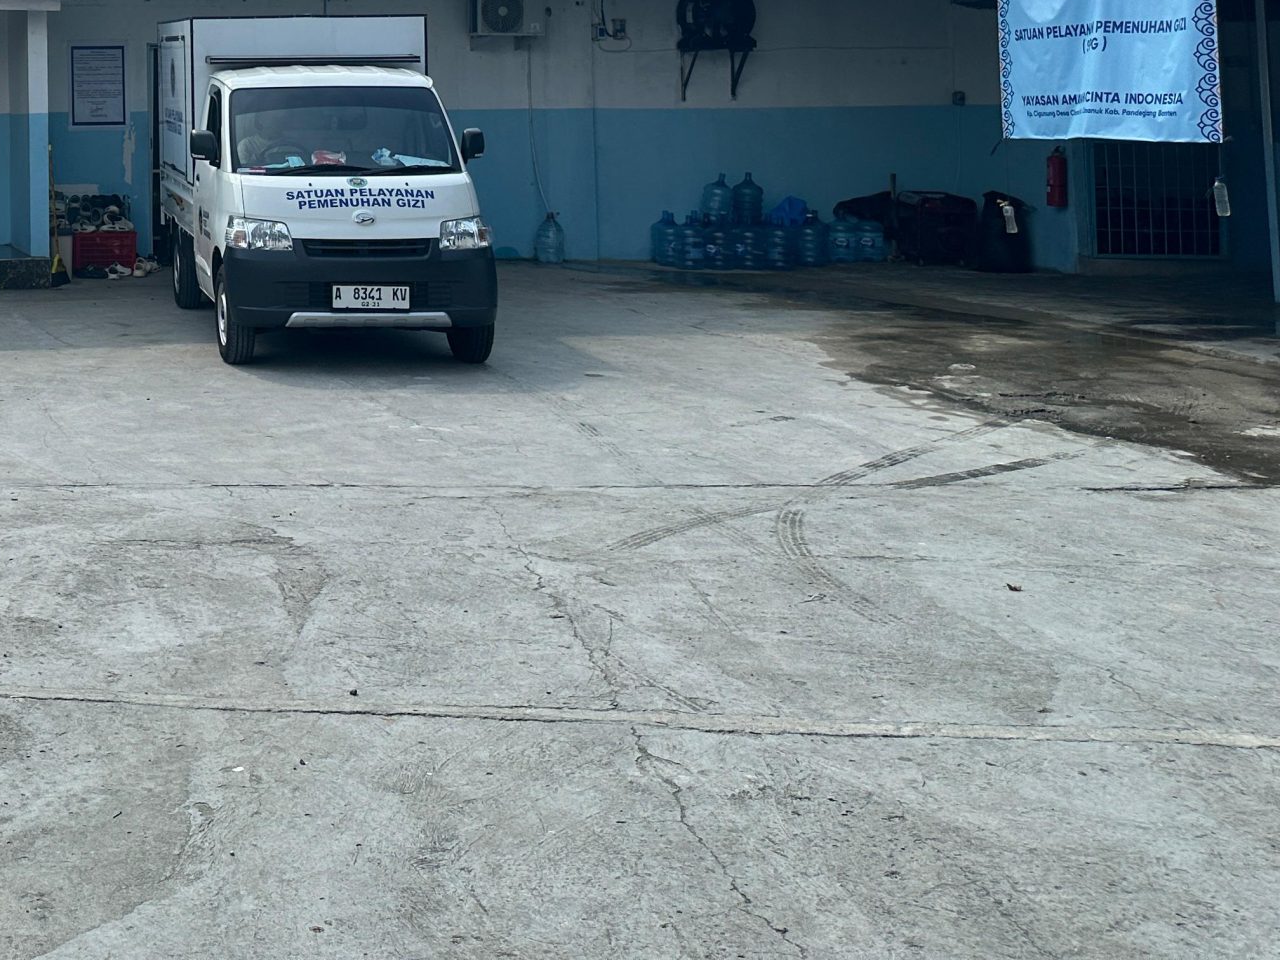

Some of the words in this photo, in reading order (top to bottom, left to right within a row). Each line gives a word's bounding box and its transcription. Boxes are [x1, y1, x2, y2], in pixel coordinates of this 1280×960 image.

[1014, 27, 1044, 41] SATUAN
[1095, 20, 1172, 34] PEMENUHAN
[1021, 94, 1059, 106] YAYASAN
[1085, 91, 1120, 104] CINTA
[1124, 92, 1183, 105] INDONESIA
[286, 189, 345, 200] SATUAN
[350, 188, 435, 199] PELAYANAN
[298, 198, 391, 209] PEMENUHAN
[396, 198, 425, 208] GIZI
[334, 287, 342, 300] A
[353, 287, 382, 300] 8341
[392, 288, 407, 301] KV
